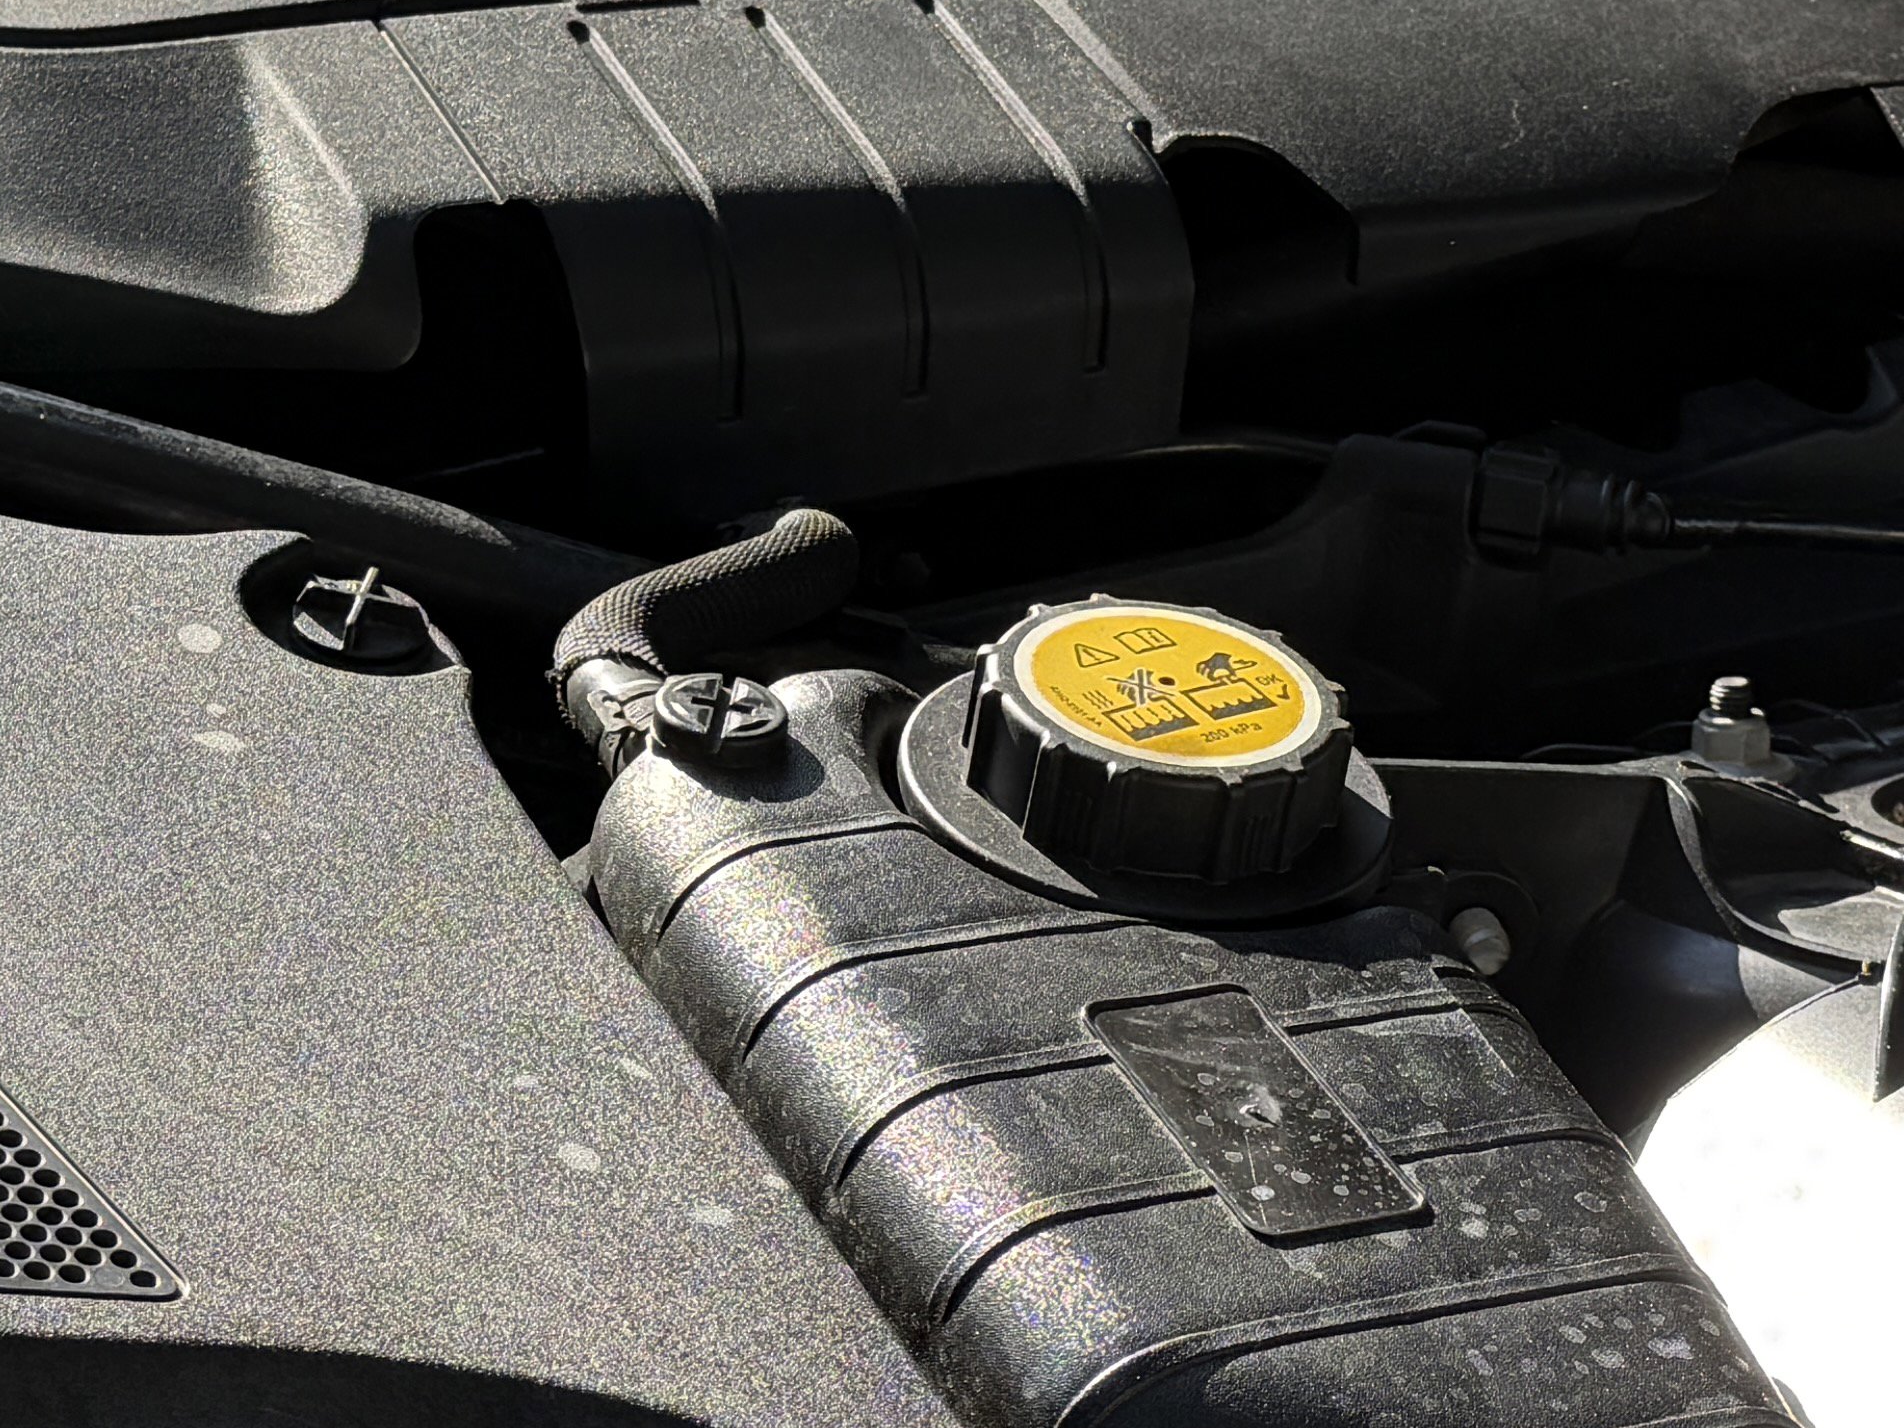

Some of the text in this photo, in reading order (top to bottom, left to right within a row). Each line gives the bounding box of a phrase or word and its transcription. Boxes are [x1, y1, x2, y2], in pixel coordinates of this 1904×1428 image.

[1255, 673, 1285, 686] OK
[1199, 722, 1263, 744] 200 kPa
